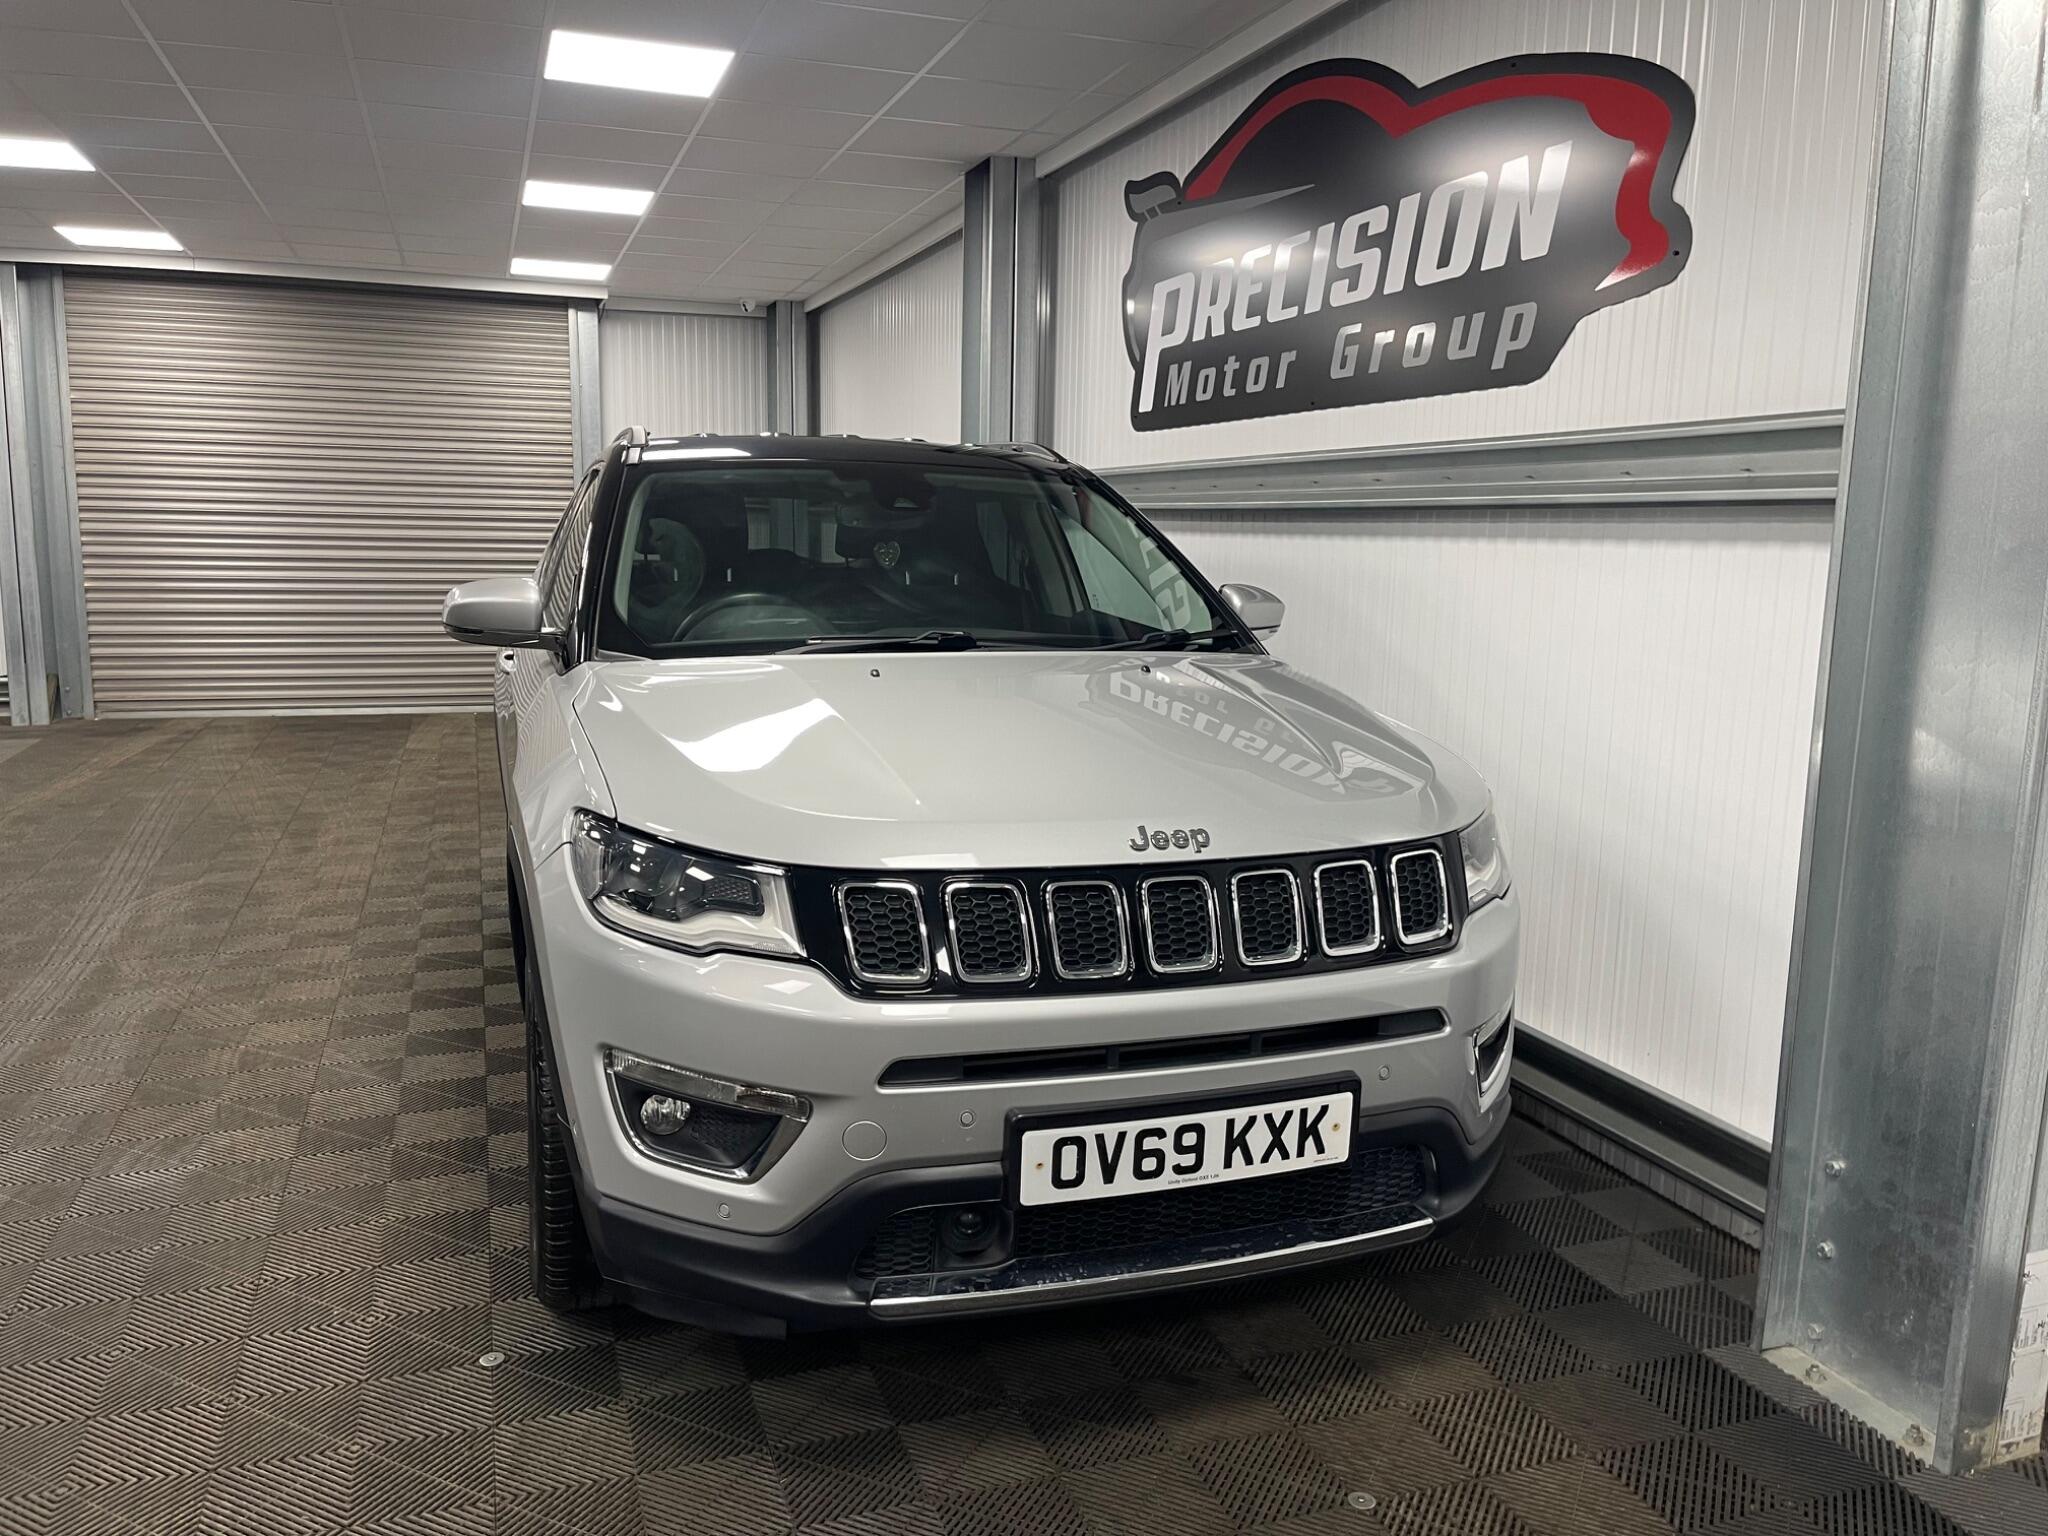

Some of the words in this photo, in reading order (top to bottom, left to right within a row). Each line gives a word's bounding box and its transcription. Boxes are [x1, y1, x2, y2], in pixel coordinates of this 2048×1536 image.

[1138, 140, 1572, 413] PRECISION
[1164, 349, 1296, 408] Motor
[1330, 301, 1538, 380] Group
[1128, 825, 1211, 853] Jeep
[1051, 1123, 1206, 1190] OV69
[1223, 1104, 1330, 1169] KXK
